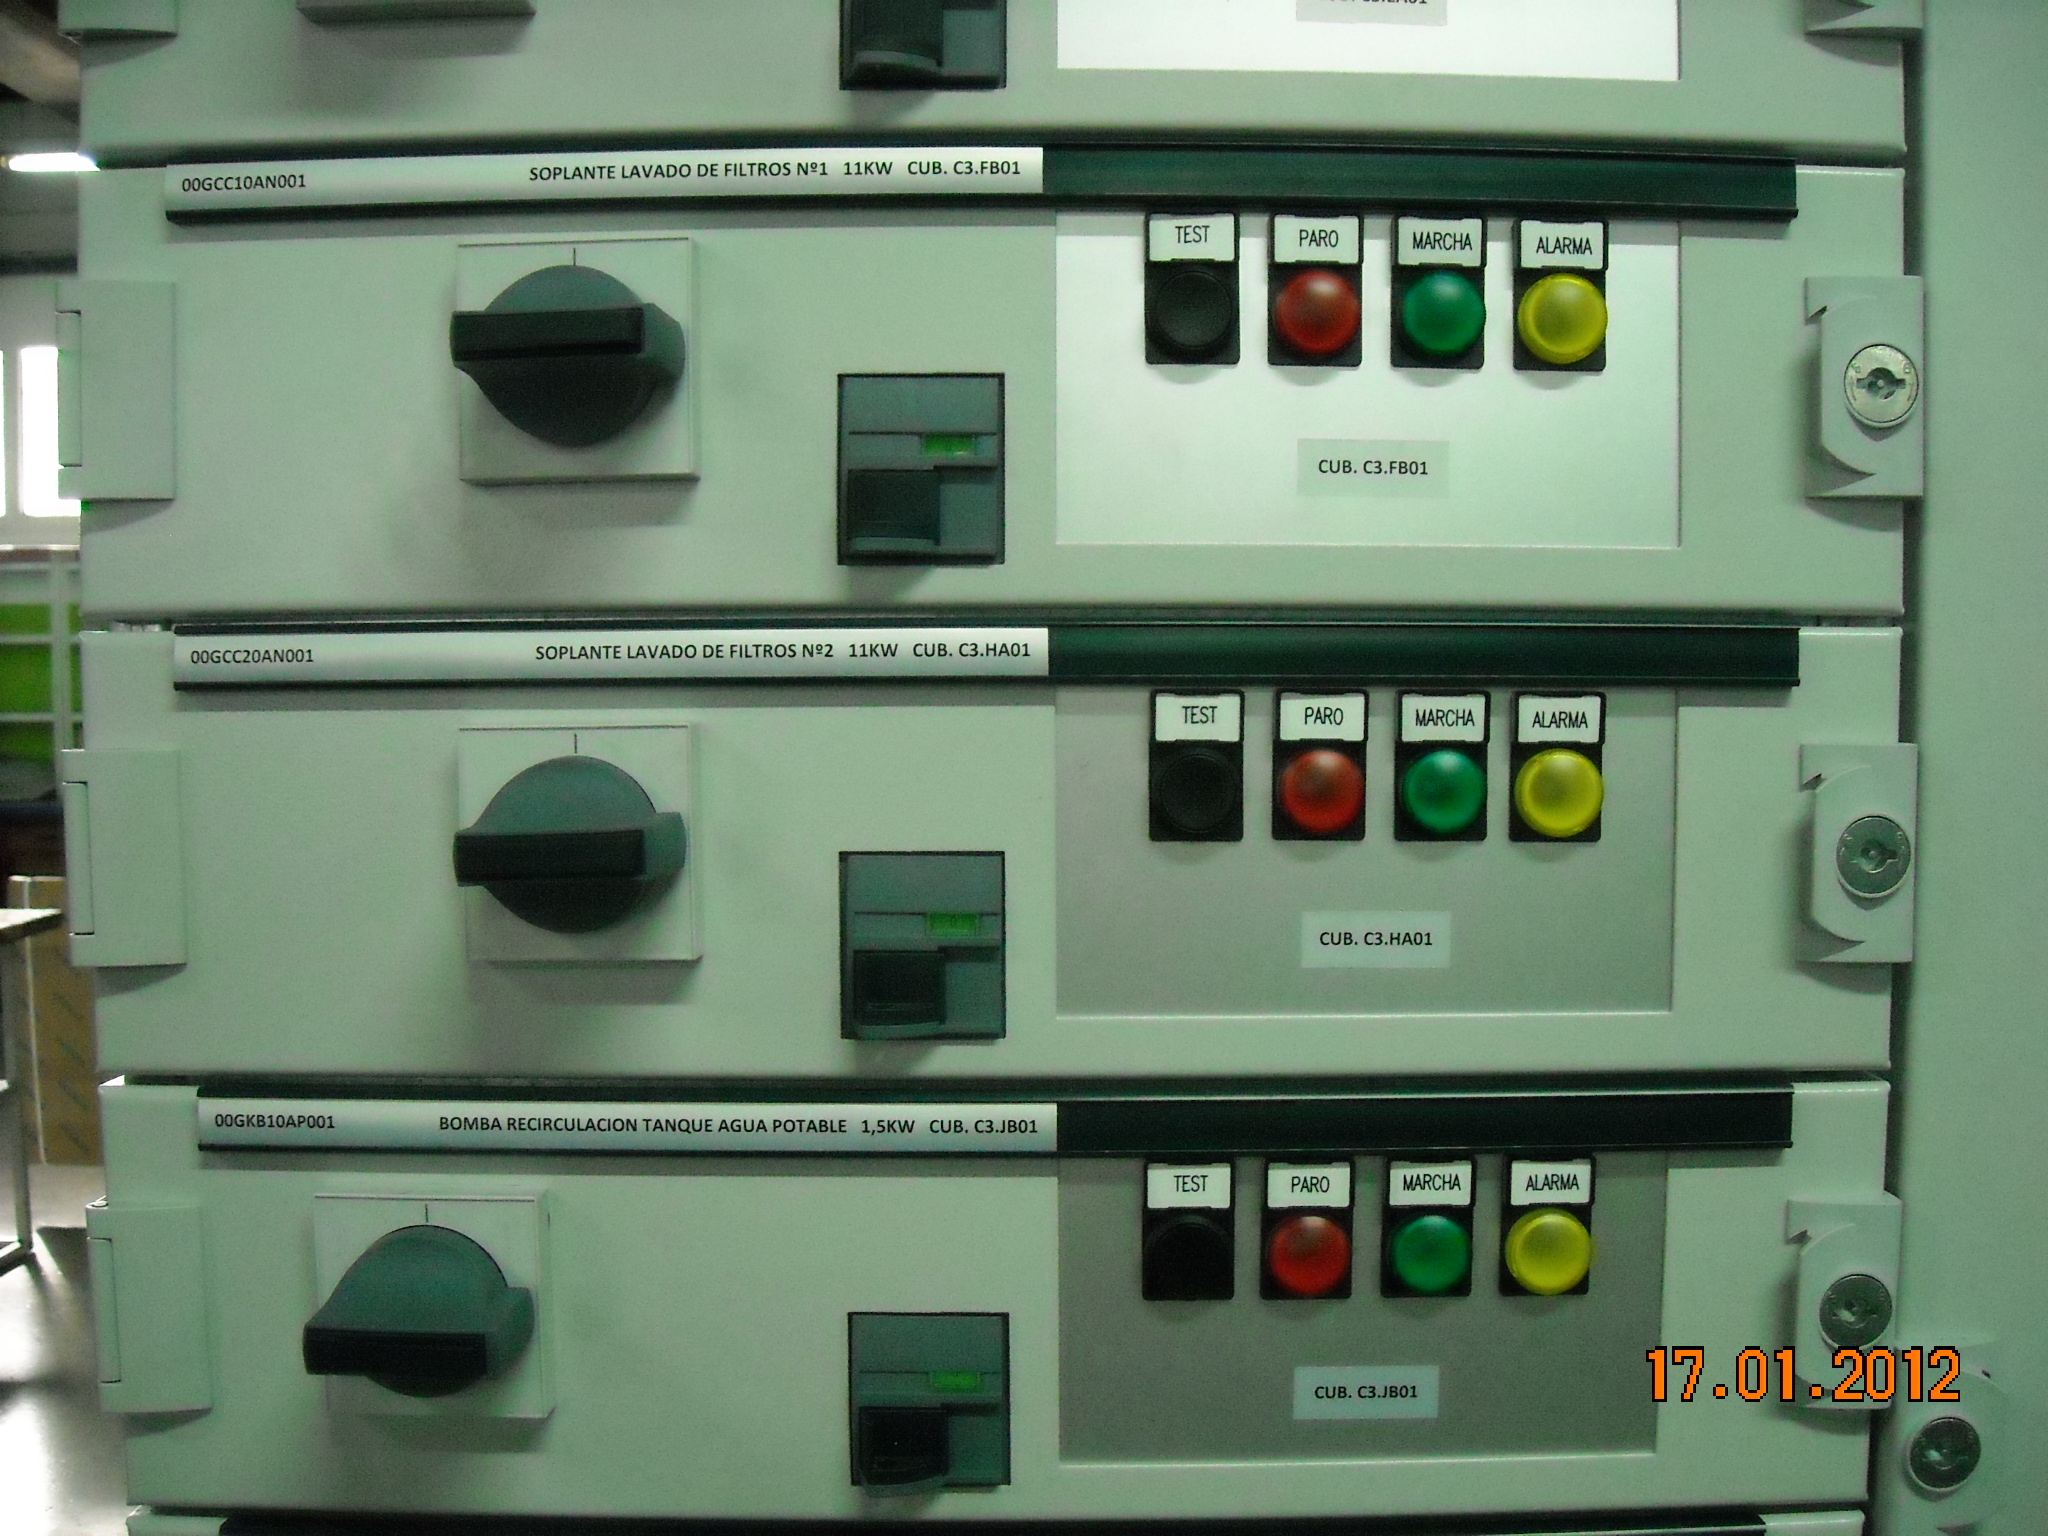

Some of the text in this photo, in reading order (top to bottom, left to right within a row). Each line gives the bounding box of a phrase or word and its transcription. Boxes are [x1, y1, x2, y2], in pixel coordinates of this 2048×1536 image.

[529, 165, 616, 182] SOPLANTE
[621, 163, 692, 180] LAVADO
[696, 163, 719, 178] DE
[724, 161, 792, 178] FILTROS
[843, 161, 894, 176] 11KW
[907, 160, 948, 176] CUB.
[952, 160, 1021, 176] C3.FB01
[181, 173, 306, 193] 00GCC10AN001
[1174, 224, 1211, 244] TEST
[1299, 228, 1339, 249] PARO
[1412, 231, 1473, 252] MARCHA
[1535, 235, 1593, 256] ALARMA
[1318, 459, 1429, 476] CUB. C3.FB01
[190, 648, 314, 665] 00GCC20AN001
[535, 645, 622, 661] SOPLANTE
[626, 644, 698, 660] LAVADO
[702, 644, 725, 659] DE
[729, 643, 797, 659] FILTROS
[848, 643, 899, 658] 11KW
[912, 642, 954, 658] CUB.
[958, 642, 1031, 658] C3.HA01
[1181, 705, 1218, 725] TEST
[1304, 706, 1344, 726] PARO
[1415, 708, 1476, 728] MARCHA
[1531, 710, 1589, 729] ALARMA
[1319, 931, 1433, 946] CUB. C3.HA01
[213, 1113, 336, 1130] 00GKB10AP001
[439, 1116, 1039, 1137] BOMBA RECIRCULACION TANQUE AGUA POTABLE 1,5KW CUB. C3.JB01
[1173, 1174, 1209, 1193] TEST
[1290, 1175, 1331, 1194] PARO
[1402, 1172, 1462, 1192] MARCHA
[1524, 1173, 1580, 1192] ALARMA
[1314, 1384, 1418, 1400] CUB. C3.JB01
